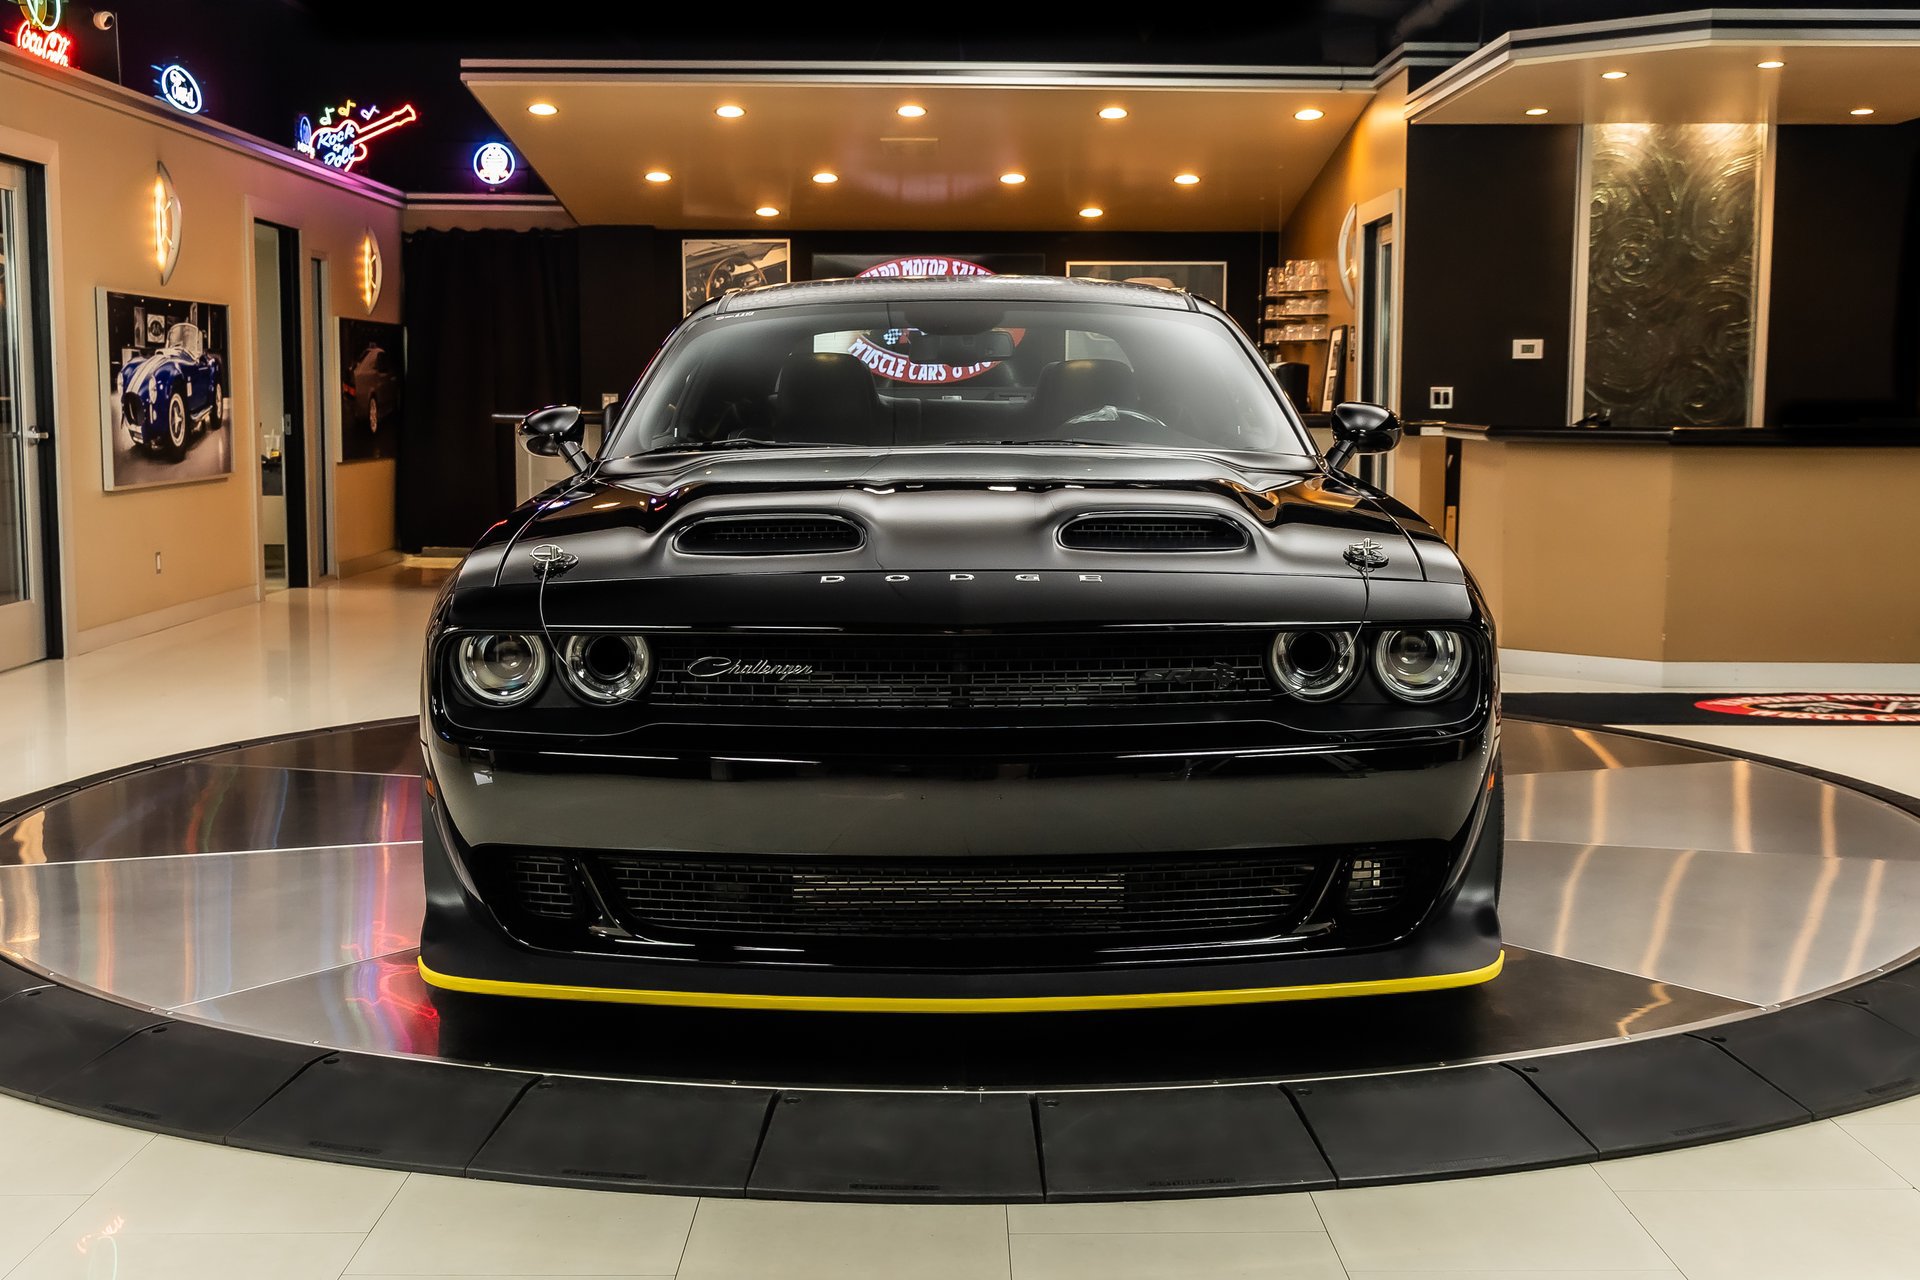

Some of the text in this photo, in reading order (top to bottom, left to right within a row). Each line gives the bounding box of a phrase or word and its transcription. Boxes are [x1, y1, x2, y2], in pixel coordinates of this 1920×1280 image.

[317, 122, 356, 149] Rock
[900, 258, 948, 276] MOTOR
[847, 338, 907, 378] MUSCLE
[908, 362, 947, 381] CARS
[820, 574, 1103, 584] DODGE
[687, 656, 813, 681] Challenger
